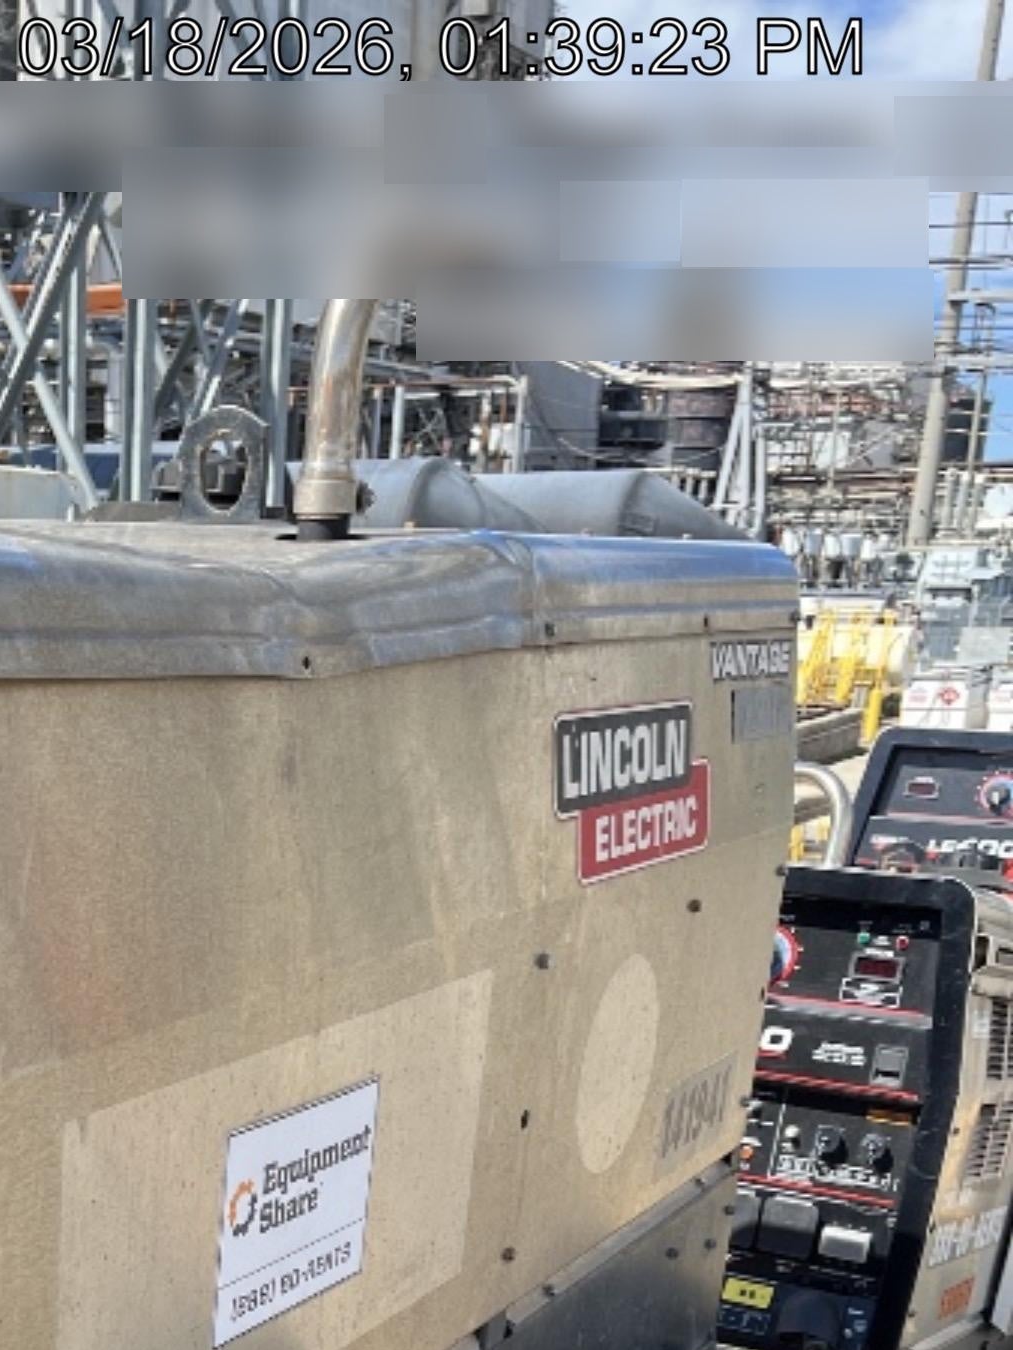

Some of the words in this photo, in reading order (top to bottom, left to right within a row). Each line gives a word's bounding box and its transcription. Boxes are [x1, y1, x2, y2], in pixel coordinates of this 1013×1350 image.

[712, 641, 790, 680] VANTAGE
[561, 718, 688, 800] LINCOLN
[594, 794, 698, 863] ELECTRIC
[263, 1123, 371, 1196] Equipment
[259, 1186, 319, 1235] Share
